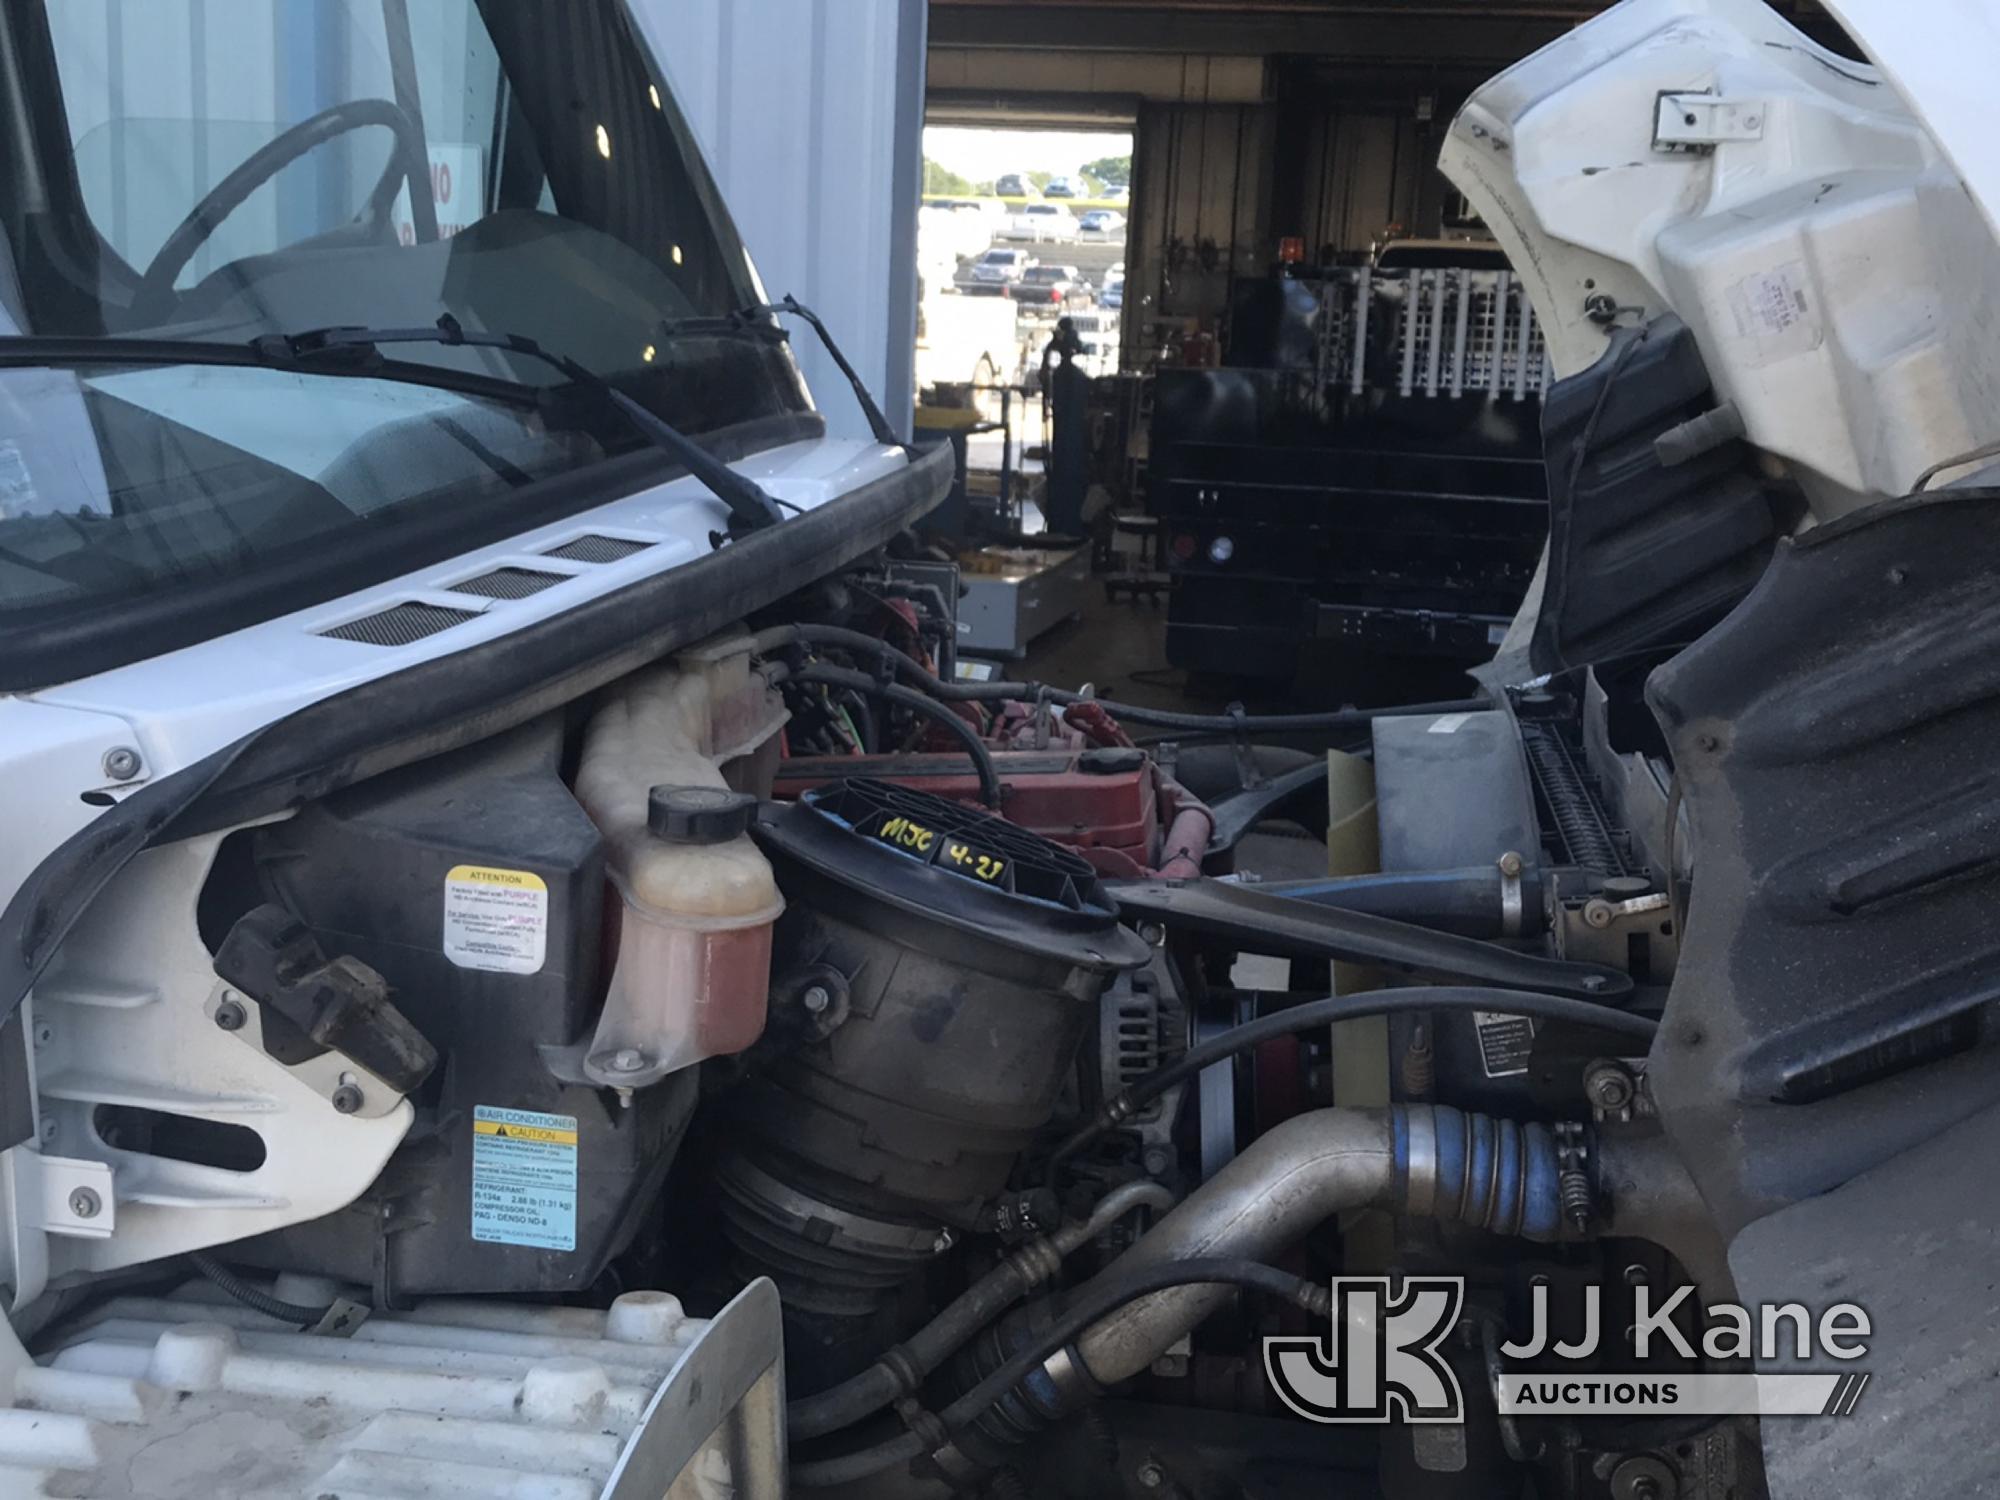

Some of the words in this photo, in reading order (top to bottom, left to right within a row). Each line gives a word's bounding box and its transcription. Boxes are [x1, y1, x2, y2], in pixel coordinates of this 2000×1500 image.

[880, 817, 934, 852] MJC
[470, 871, 522, 884] ATTENTION
[503, 889, 539, 901] PURPLE
[486, 1109, 505, 1120] AIR
[505, 1111, 576, 1128] CONDITIONER
[510, 1127, 556, 1140] CAUTION
[475, 1202, 525, 1214] COMPRESSOR
[529, 1197, 537, 1205] lb
[559, 1201, 573, 1211] kg)
[475, 1211, 491, 1220] PAG
[497, 1213, 527, 1224] DENSO
